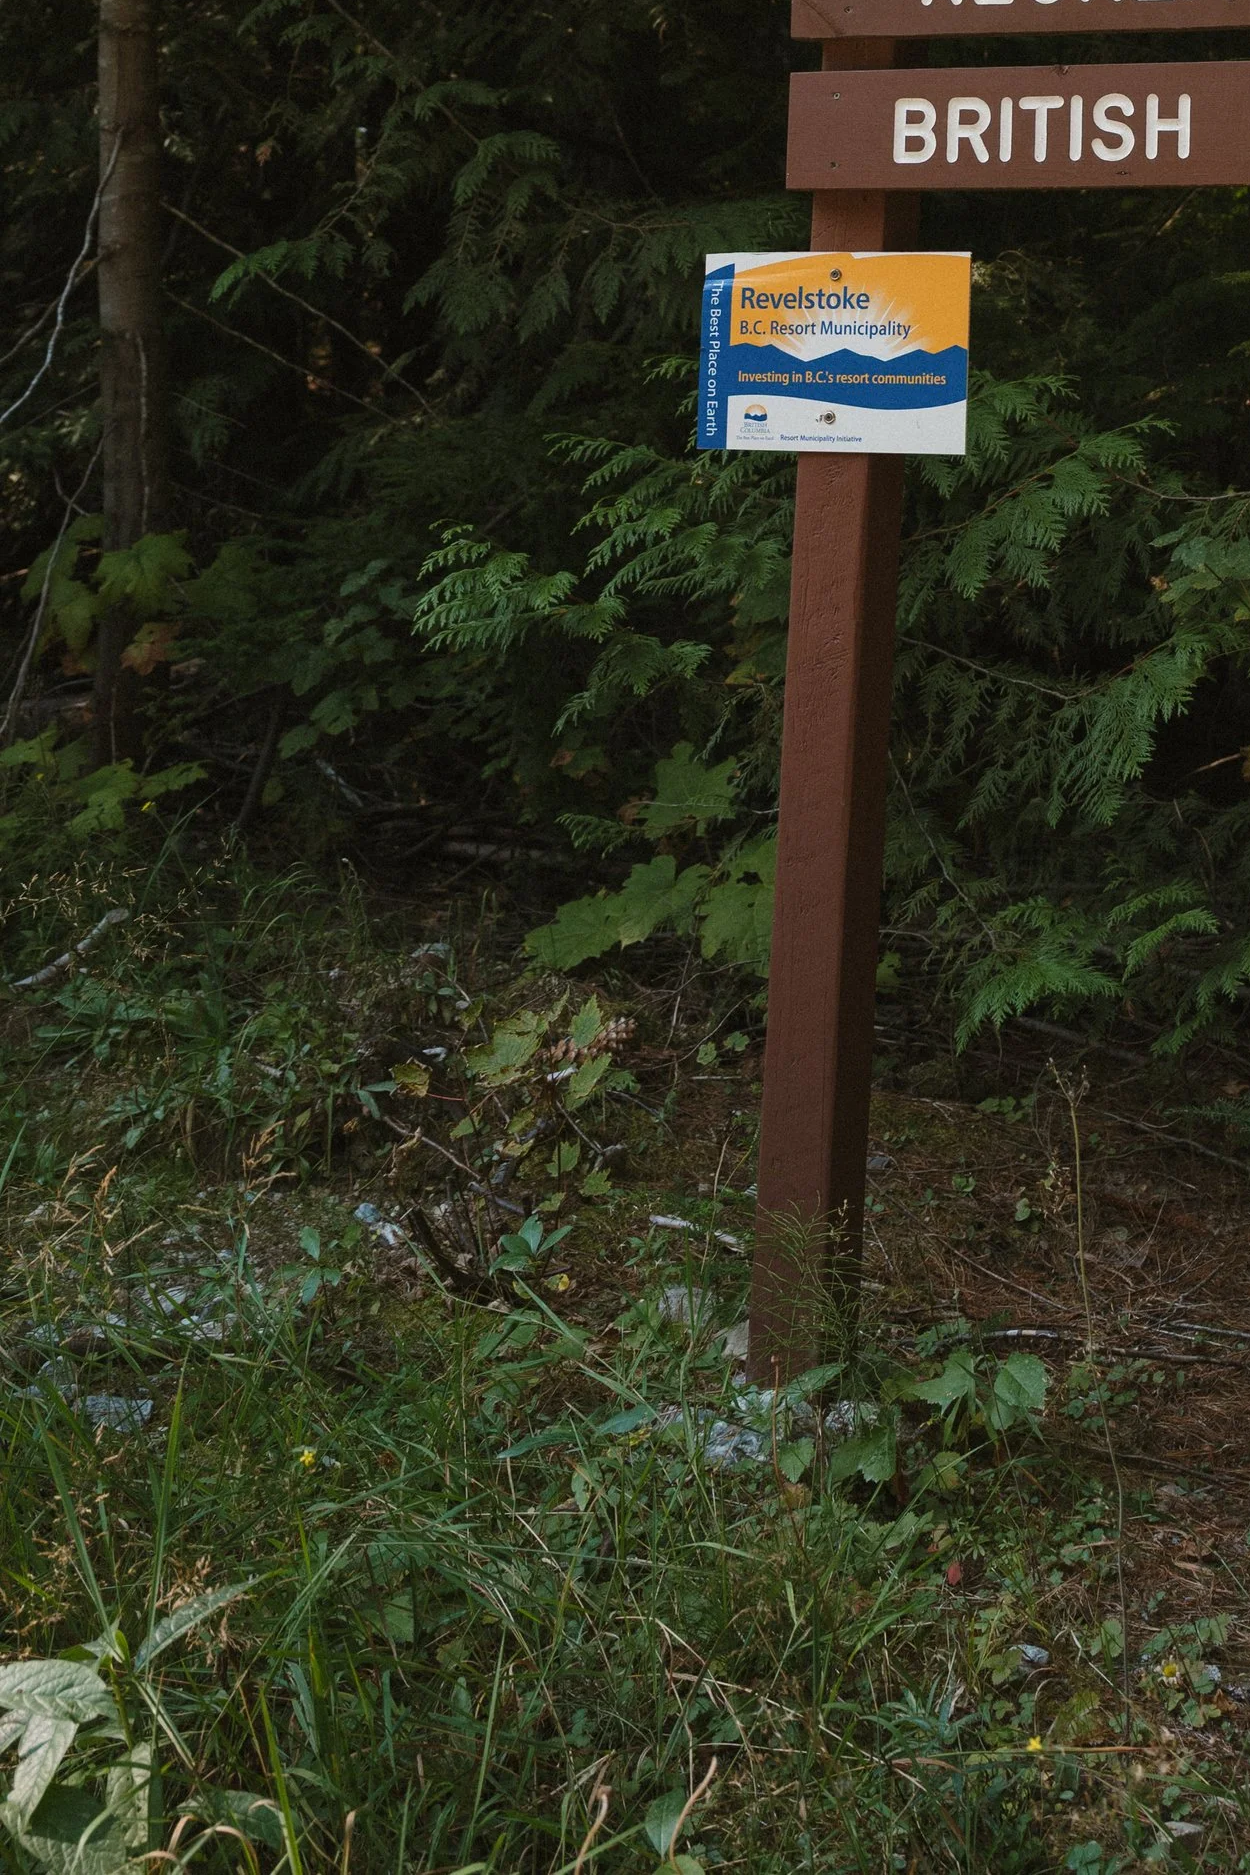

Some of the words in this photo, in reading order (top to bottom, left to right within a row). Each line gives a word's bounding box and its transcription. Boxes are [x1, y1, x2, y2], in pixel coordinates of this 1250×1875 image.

[892, 92, 1192, 165] BRITISH
[710, 280, 725, 305] The
[740, 285, 870, 310] Revelstoke
[709, 308, 721, 337] Best
[739, 320, 766, 335] B.C.
[770, 321, 817, 336] Resort
[820, 321, 911, 339] Municipality
[708, 340, 721, 376] Place
[707, 380, 717, 397] on
[738, 370, 790, 386] Investing
[792, 371, 803, 383] in
[805, 371, 834, 384] B.C.'s
[836, 372, 870, 385] resort
[871, 371, 947, 385] communities
[706, 401, 718, 436] Earth
[780, 434, 799, 442] Resort
[800, 434, 835, 443] Municipality
[836, 435, 862, 443] Initiative
